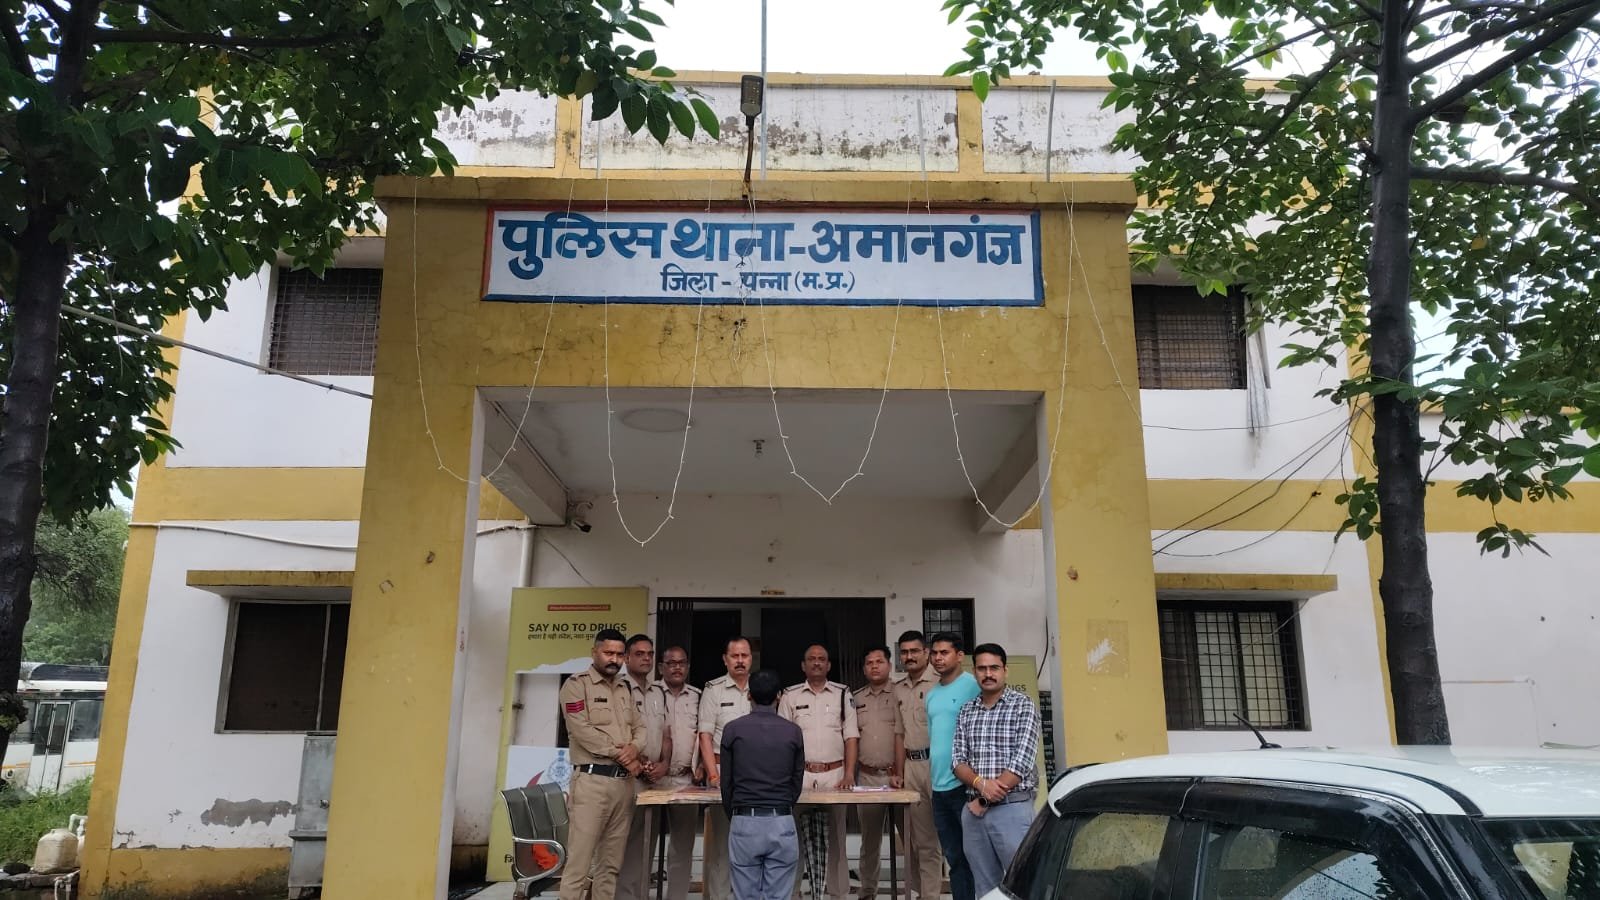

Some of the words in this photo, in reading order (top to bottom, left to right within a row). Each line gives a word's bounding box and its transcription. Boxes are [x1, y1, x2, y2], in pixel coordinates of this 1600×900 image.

[498, 211, 668, 280] पुलिस
[660, 263, 719, 294] जिला
[528, 623, 549, 632] SAY
[552, 623, 569, 632] NO
[572, 623, 587, 632] TO
